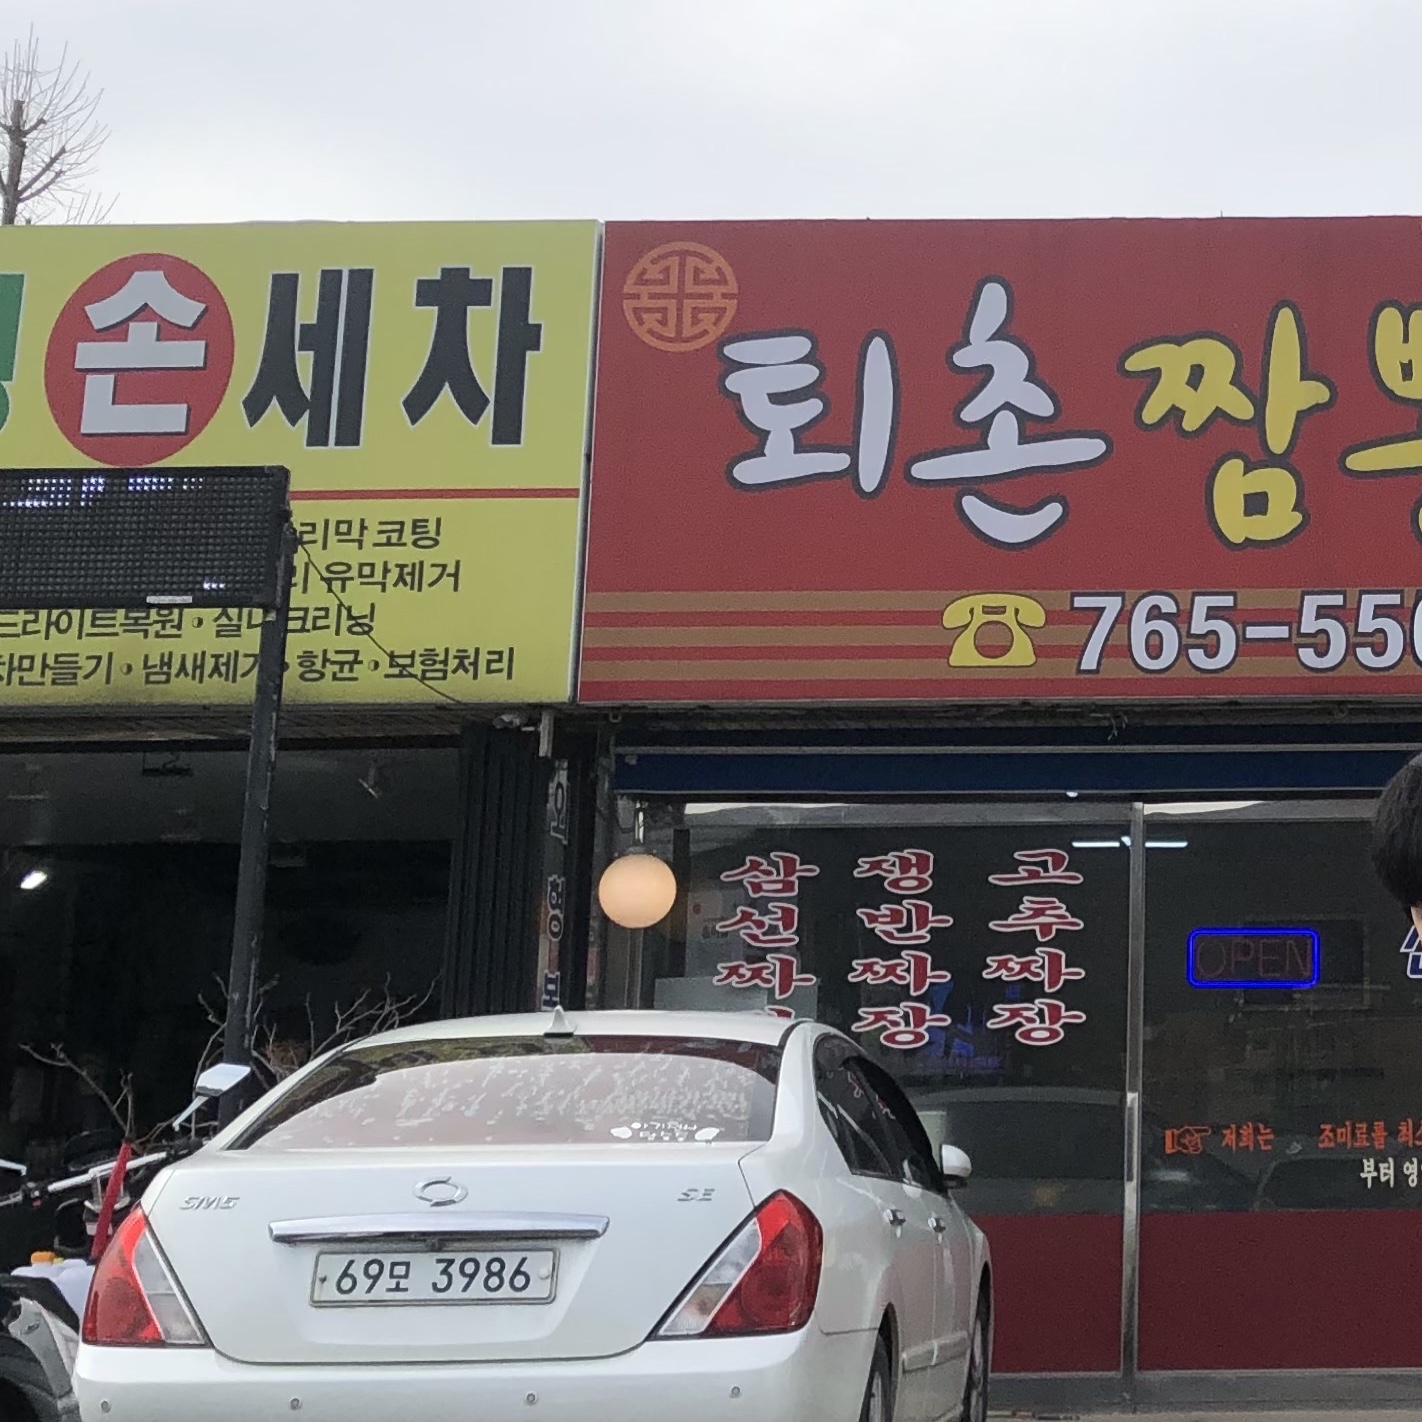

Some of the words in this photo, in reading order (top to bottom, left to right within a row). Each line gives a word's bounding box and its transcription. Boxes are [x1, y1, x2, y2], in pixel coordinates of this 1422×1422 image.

[320, 560, 461, 593] 유막제거
[297, 649, 364, 682] 항균
[384, 647, 515, 680] 보험처리
[713, 851, 820, 1018] 삼선짜
[1194, 939, 1312, 979] OPEN
[1221, 1122, 1275, 1153] 저희는
[1318, 1119, 1388, 1150] 조미료를
[1360, 1157, 1395, 1189] 부터
[179, 1196, 240, 1210] SM5
[335, 1258, 411, 1295] 69모
[431, 1256, 531, 1293] 3986
